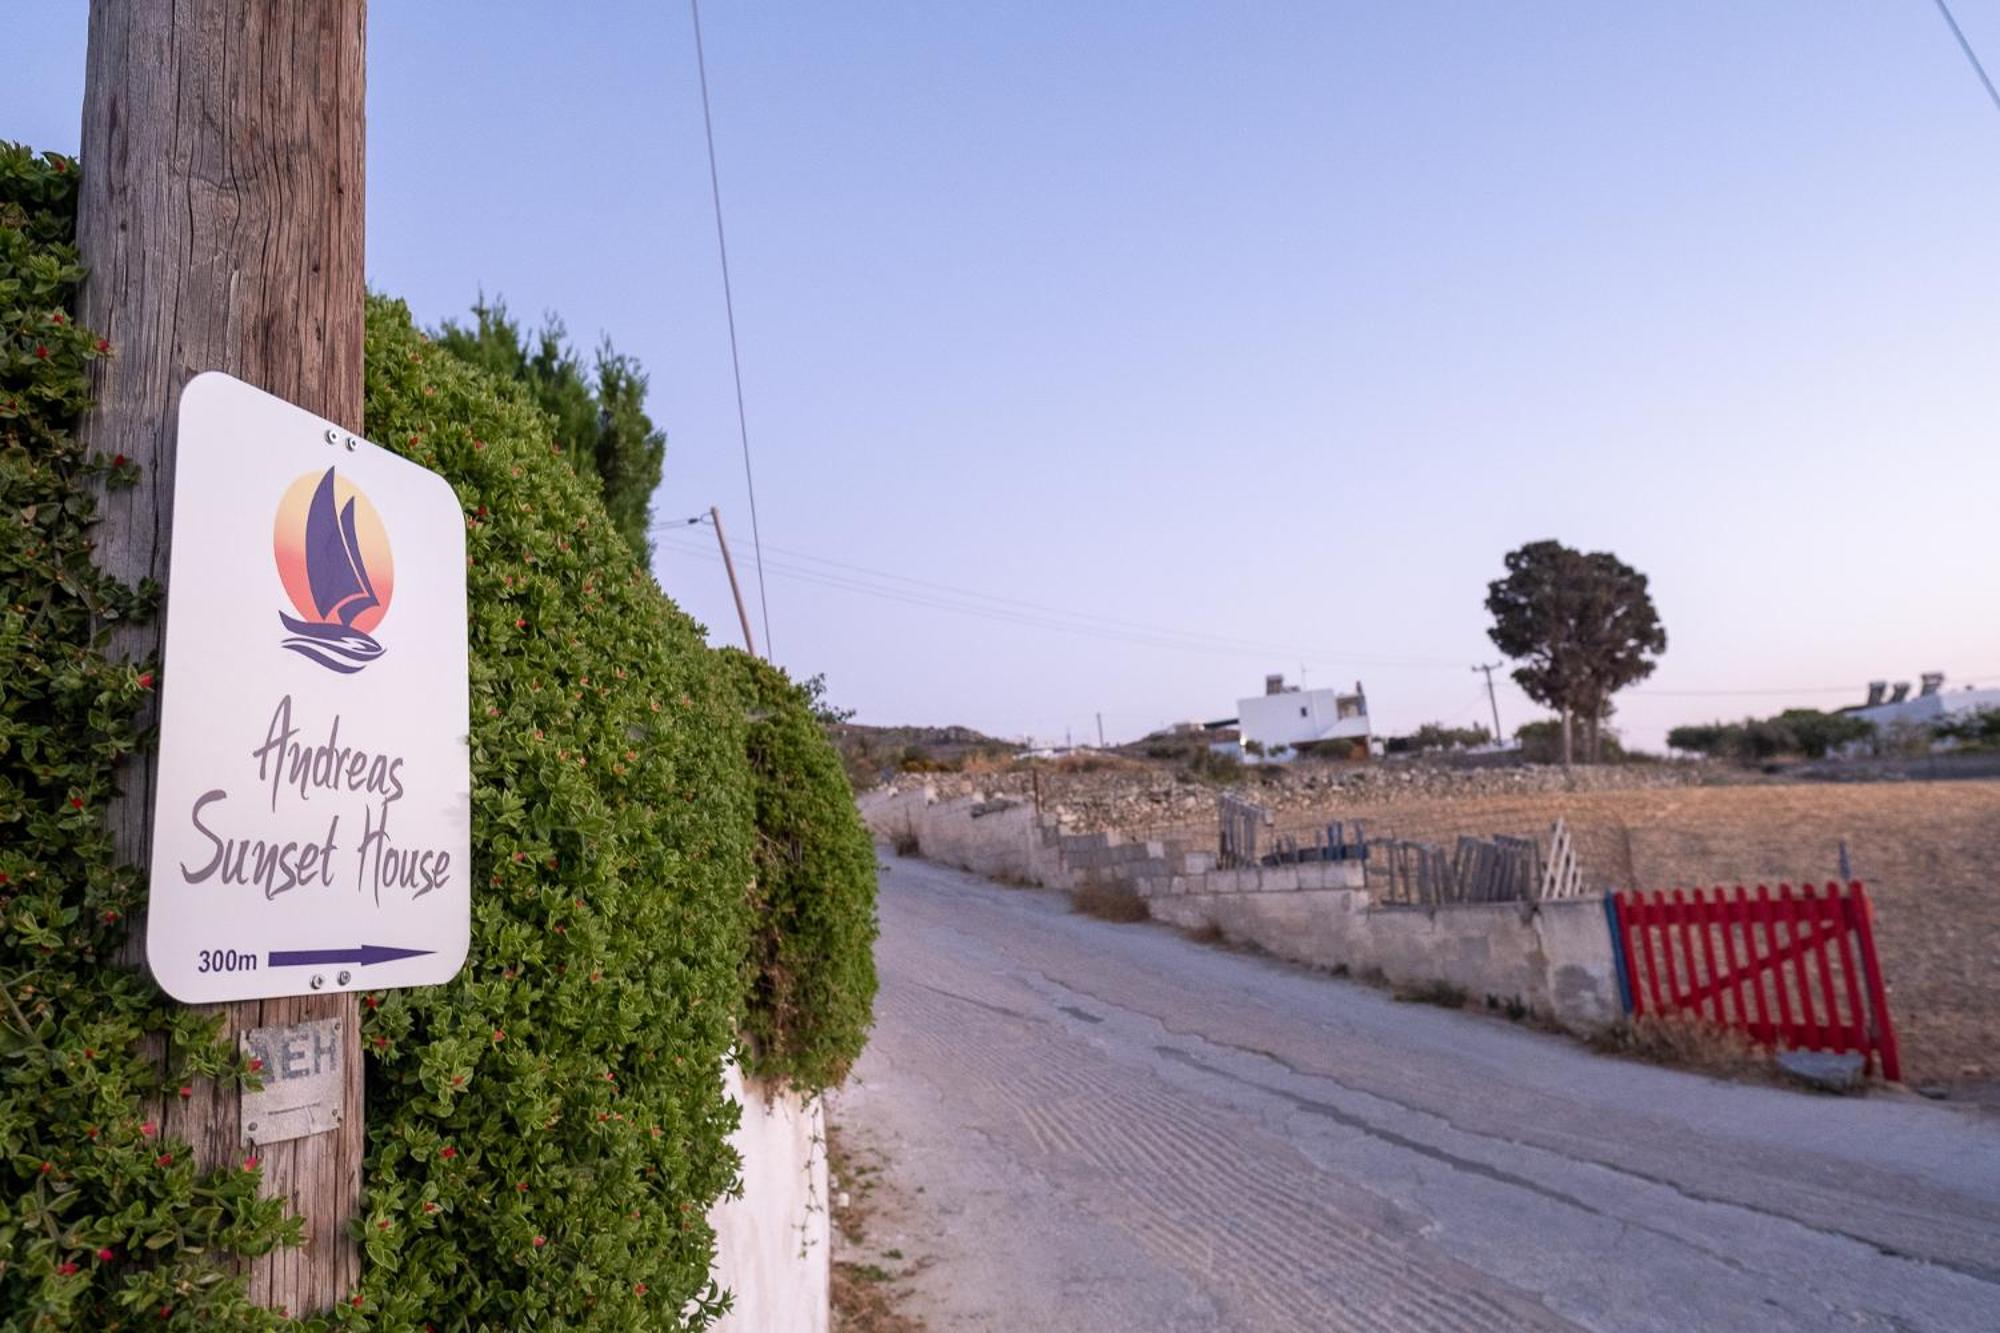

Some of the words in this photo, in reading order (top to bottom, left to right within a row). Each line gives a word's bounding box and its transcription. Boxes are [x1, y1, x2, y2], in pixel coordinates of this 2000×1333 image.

[253, 694, 404, 813] Andreas
[180, 789, 340, 900] Sunset
[357, 798, 451, 908] House
[198, 949, 257, 973] 300m
